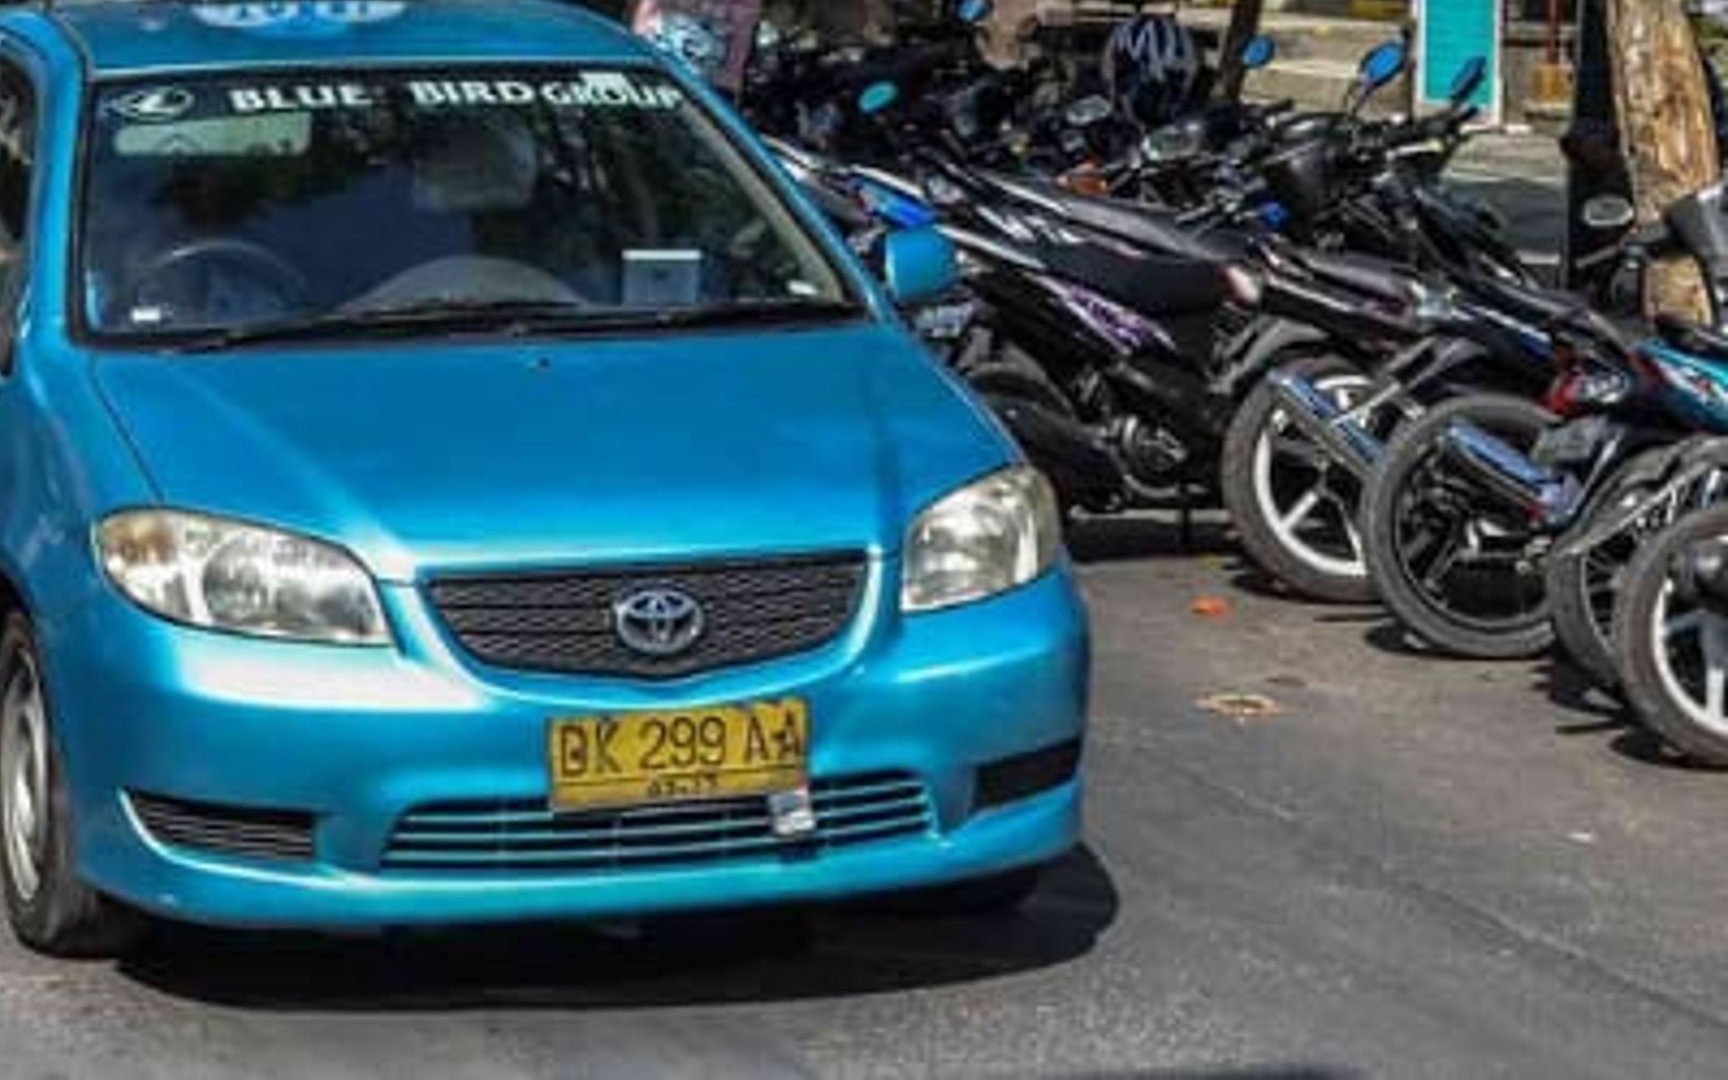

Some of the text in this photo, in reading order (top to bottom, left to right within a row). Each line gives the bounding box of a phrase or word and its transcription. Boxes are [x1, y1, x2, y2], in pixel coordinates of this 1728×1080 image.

[229, 79, 682, 112] BLUE BIRD GROUP
[638, 717, 727, 770] 299
